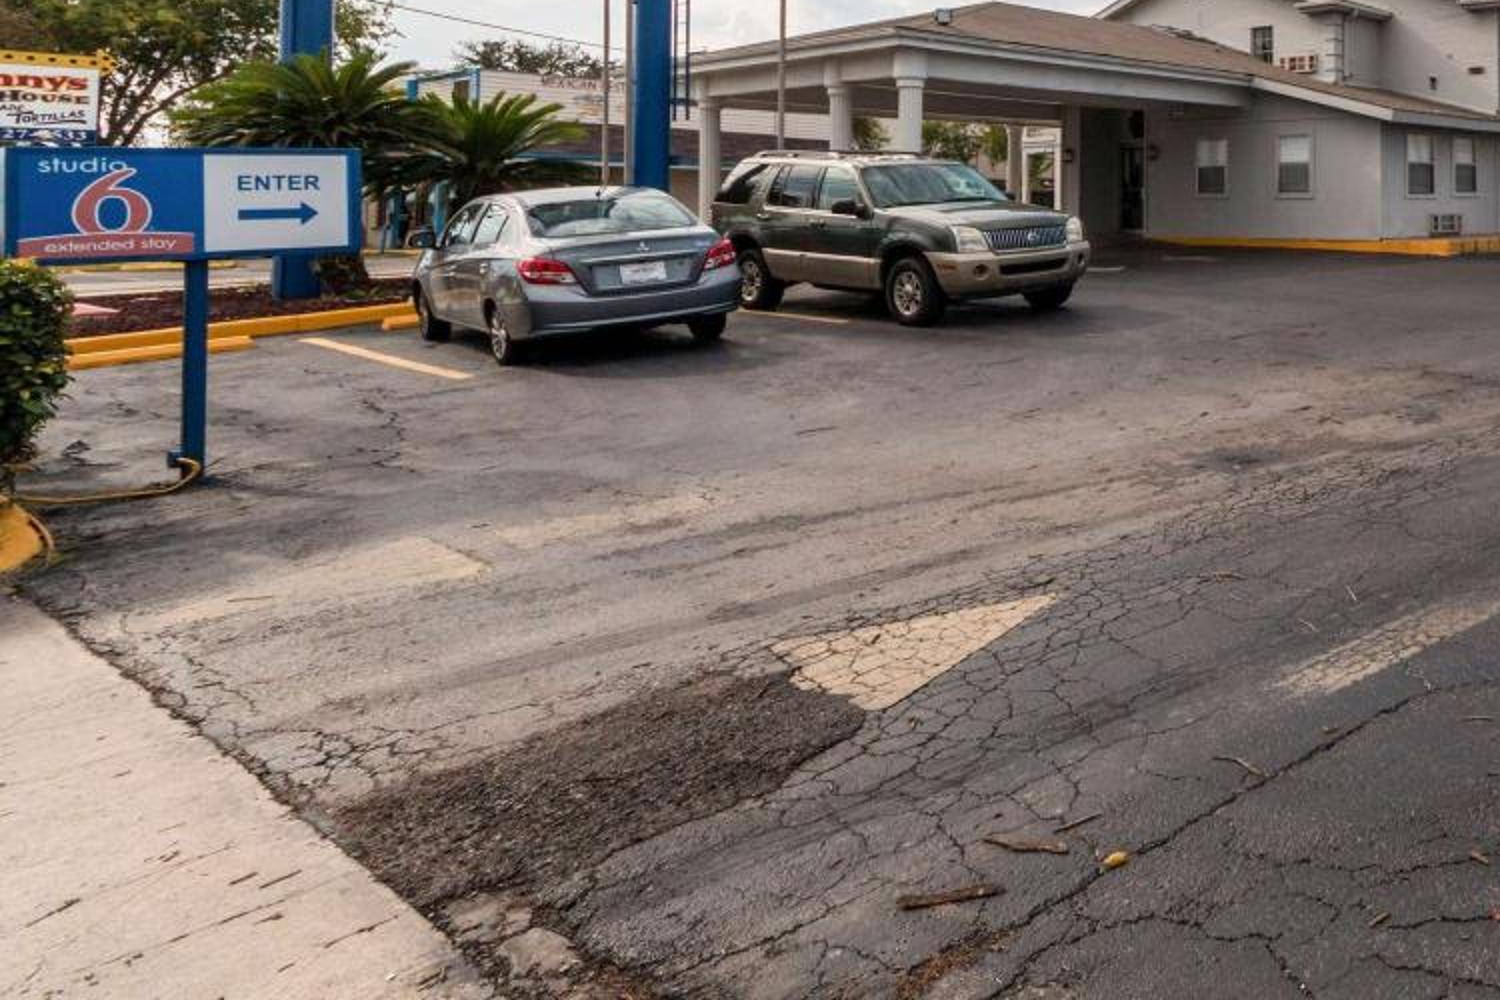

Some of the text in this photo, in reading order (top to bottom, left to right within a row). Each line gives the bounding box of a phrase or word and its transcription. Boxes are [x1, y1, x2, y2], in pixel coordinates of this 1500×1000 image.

[0, 89, 90, 105] HOUSE
[6, 109, 86, 124] TORTILLAS
[37, 156, 128, 173] studio
[237, 174, 320, 191] ENTER
[71, 167, 153, 234] 6
[44, 237, 177, 253] extended stay
